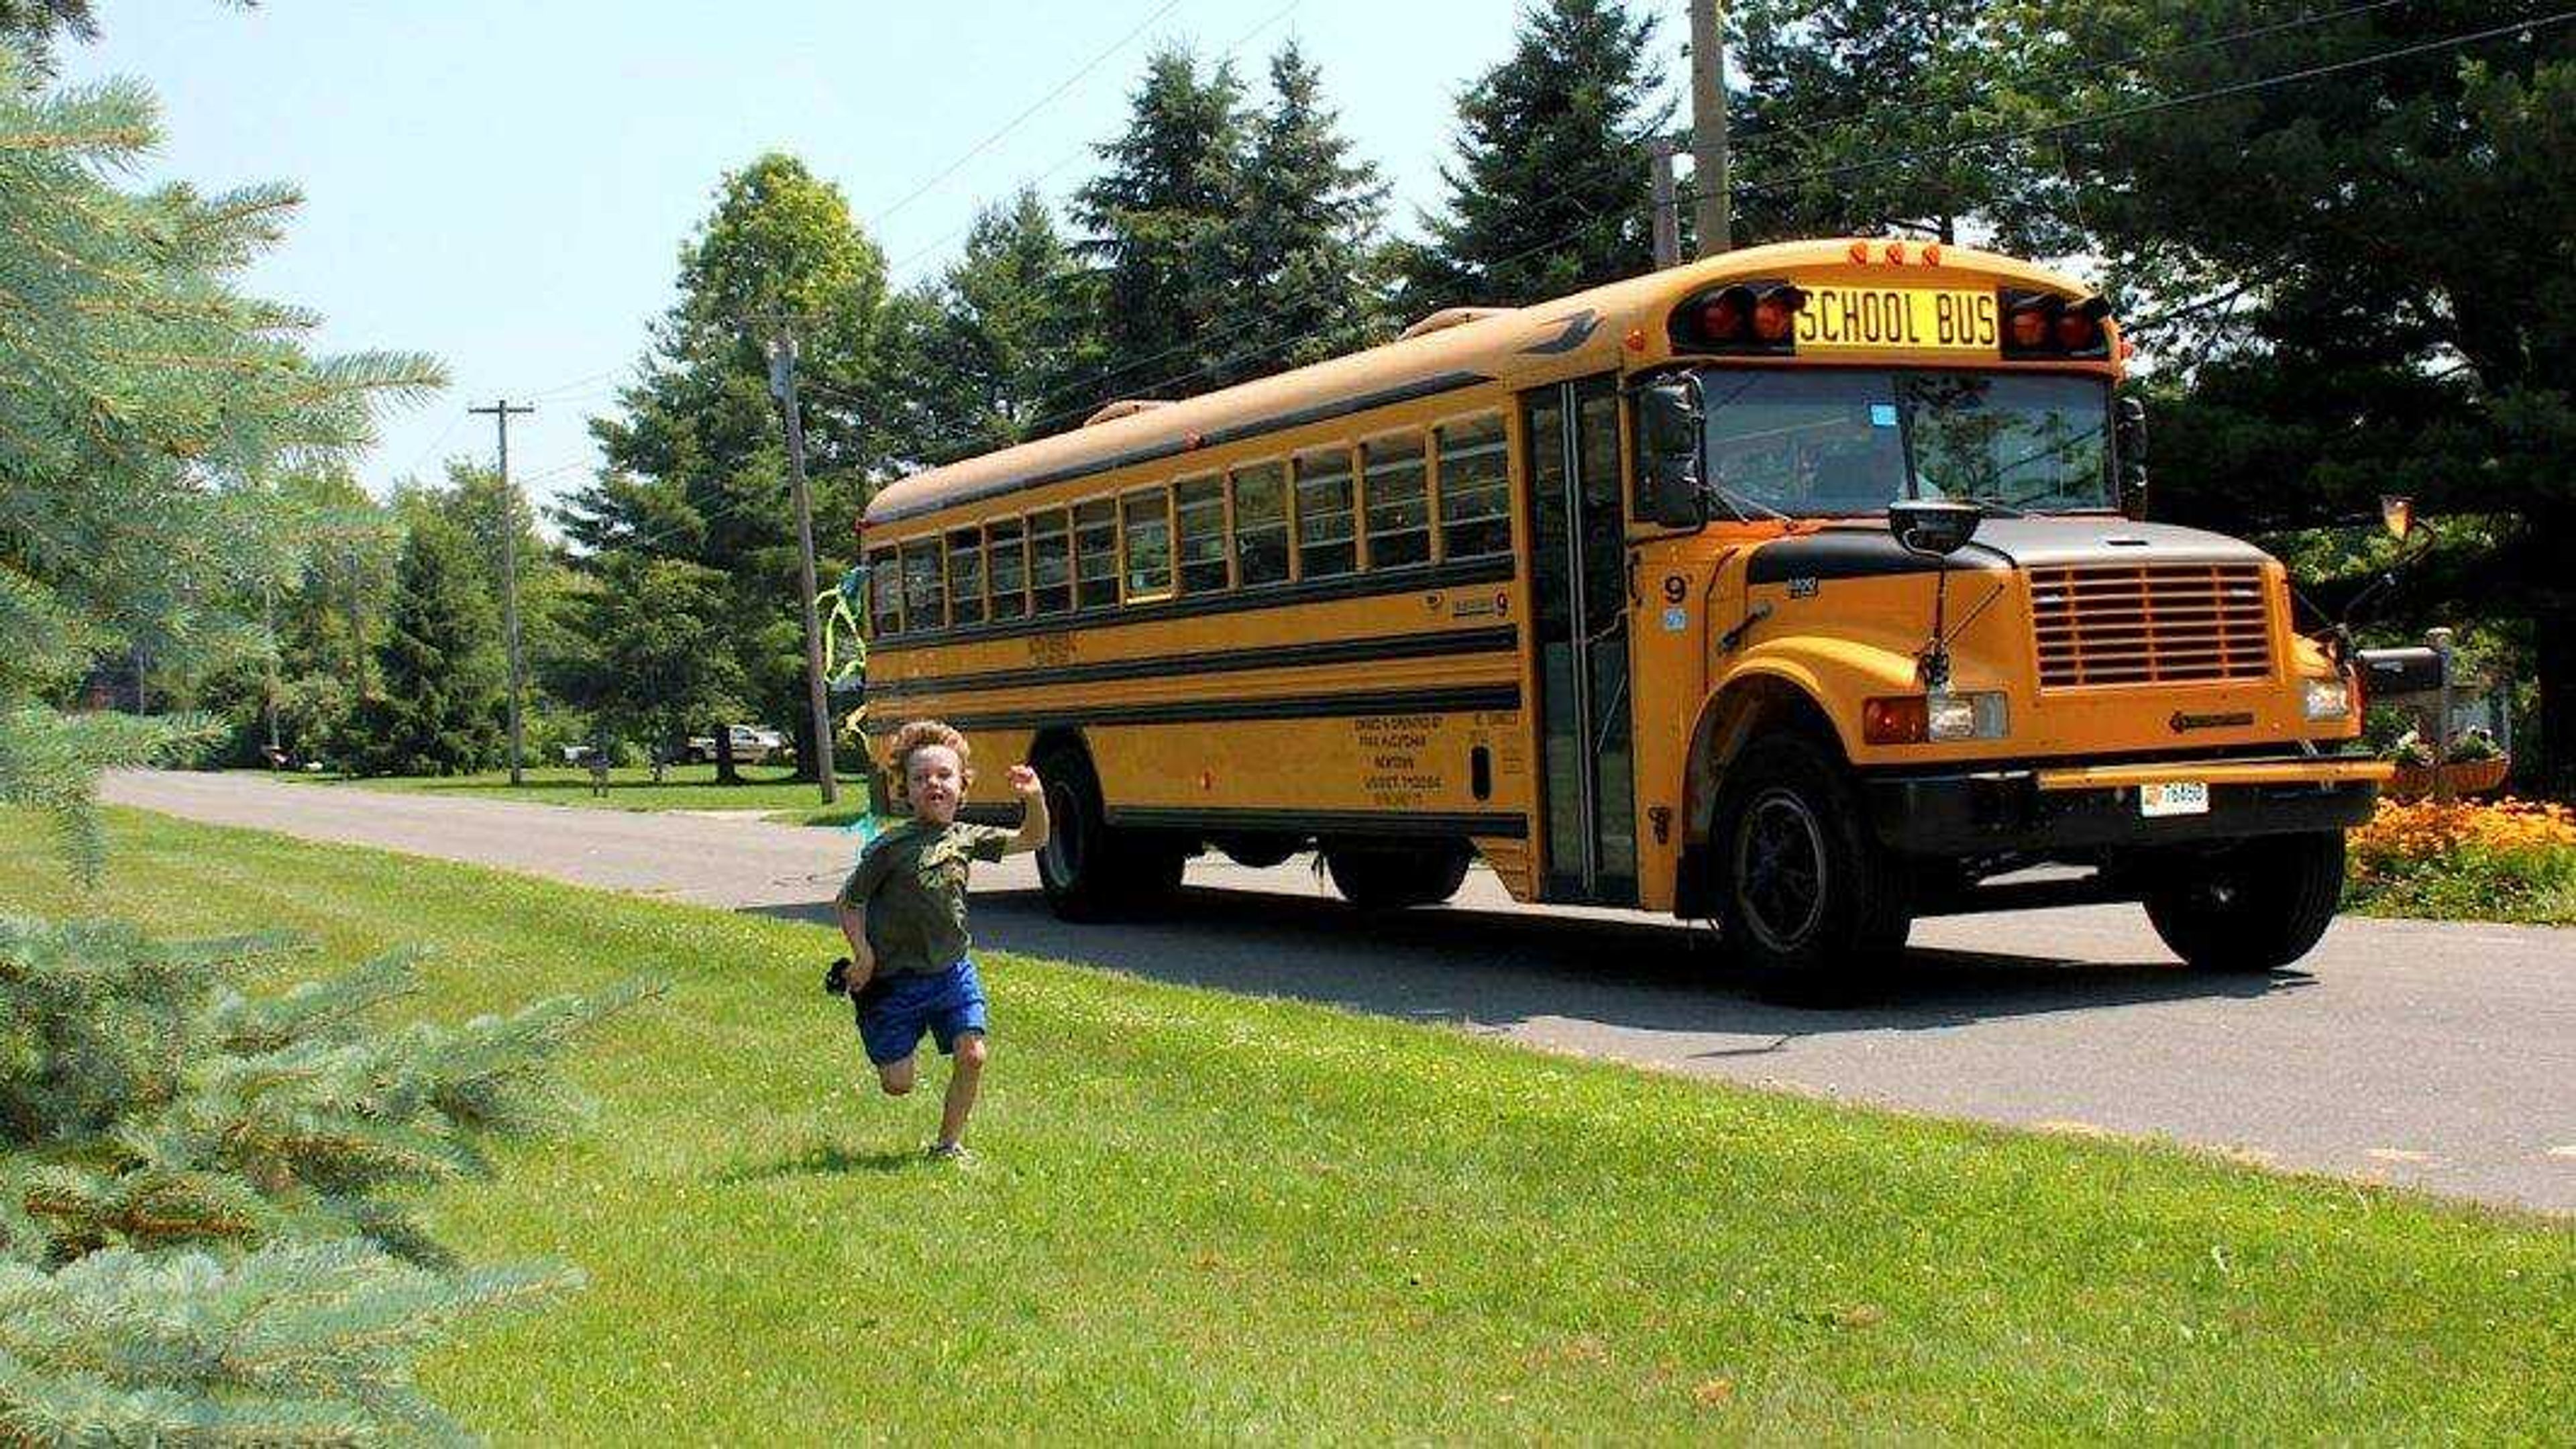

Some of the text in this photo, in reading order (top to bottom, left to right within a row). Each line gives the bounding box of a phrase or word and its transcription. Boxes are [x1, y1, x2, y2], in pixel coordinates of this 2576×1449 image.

[1799, 290, 1997, 345] SCHOOL BUS
[1497, 592, 1508, 616] 9
[1664, 576, 1686, 604] 9
